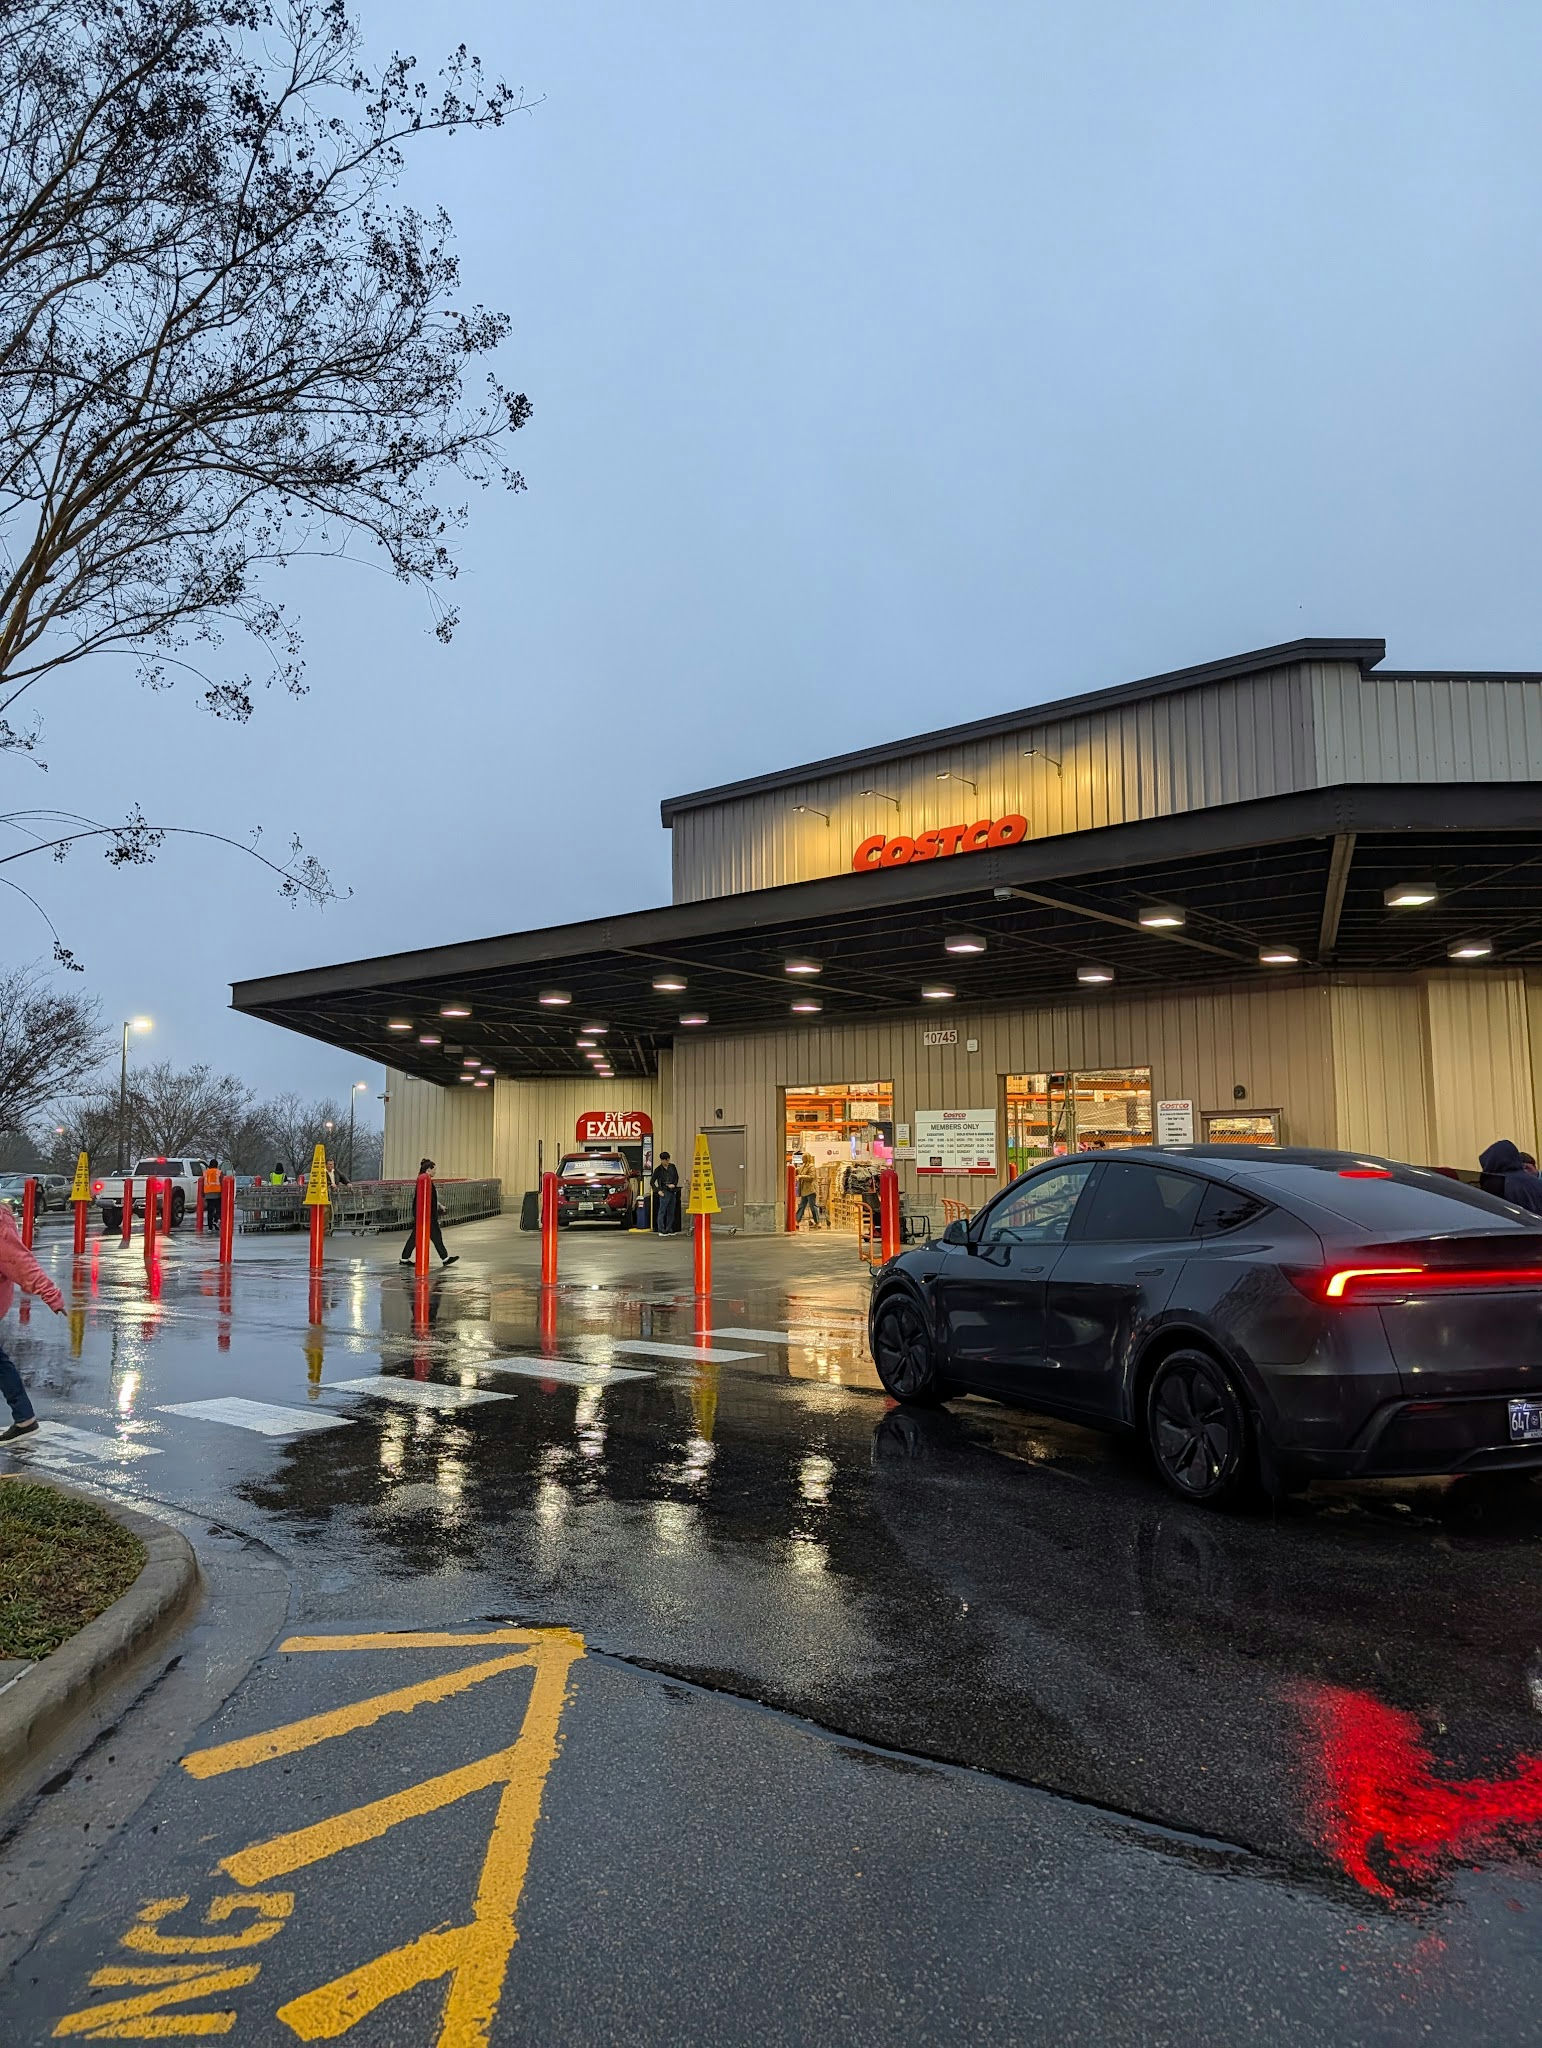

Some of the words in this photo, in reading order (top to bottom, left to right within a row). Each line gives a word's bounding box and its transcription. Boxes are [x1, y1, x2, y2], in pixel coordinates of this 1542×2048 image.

[853, 814, 1028, 871] COSTCO
[925, 1031, 956, 1044] 10745
[605, 1112, 624, 1121] EYE
[586, 1121, 642, 1137] EXAMS
[1511, 1412, 1530, 1431] 647
